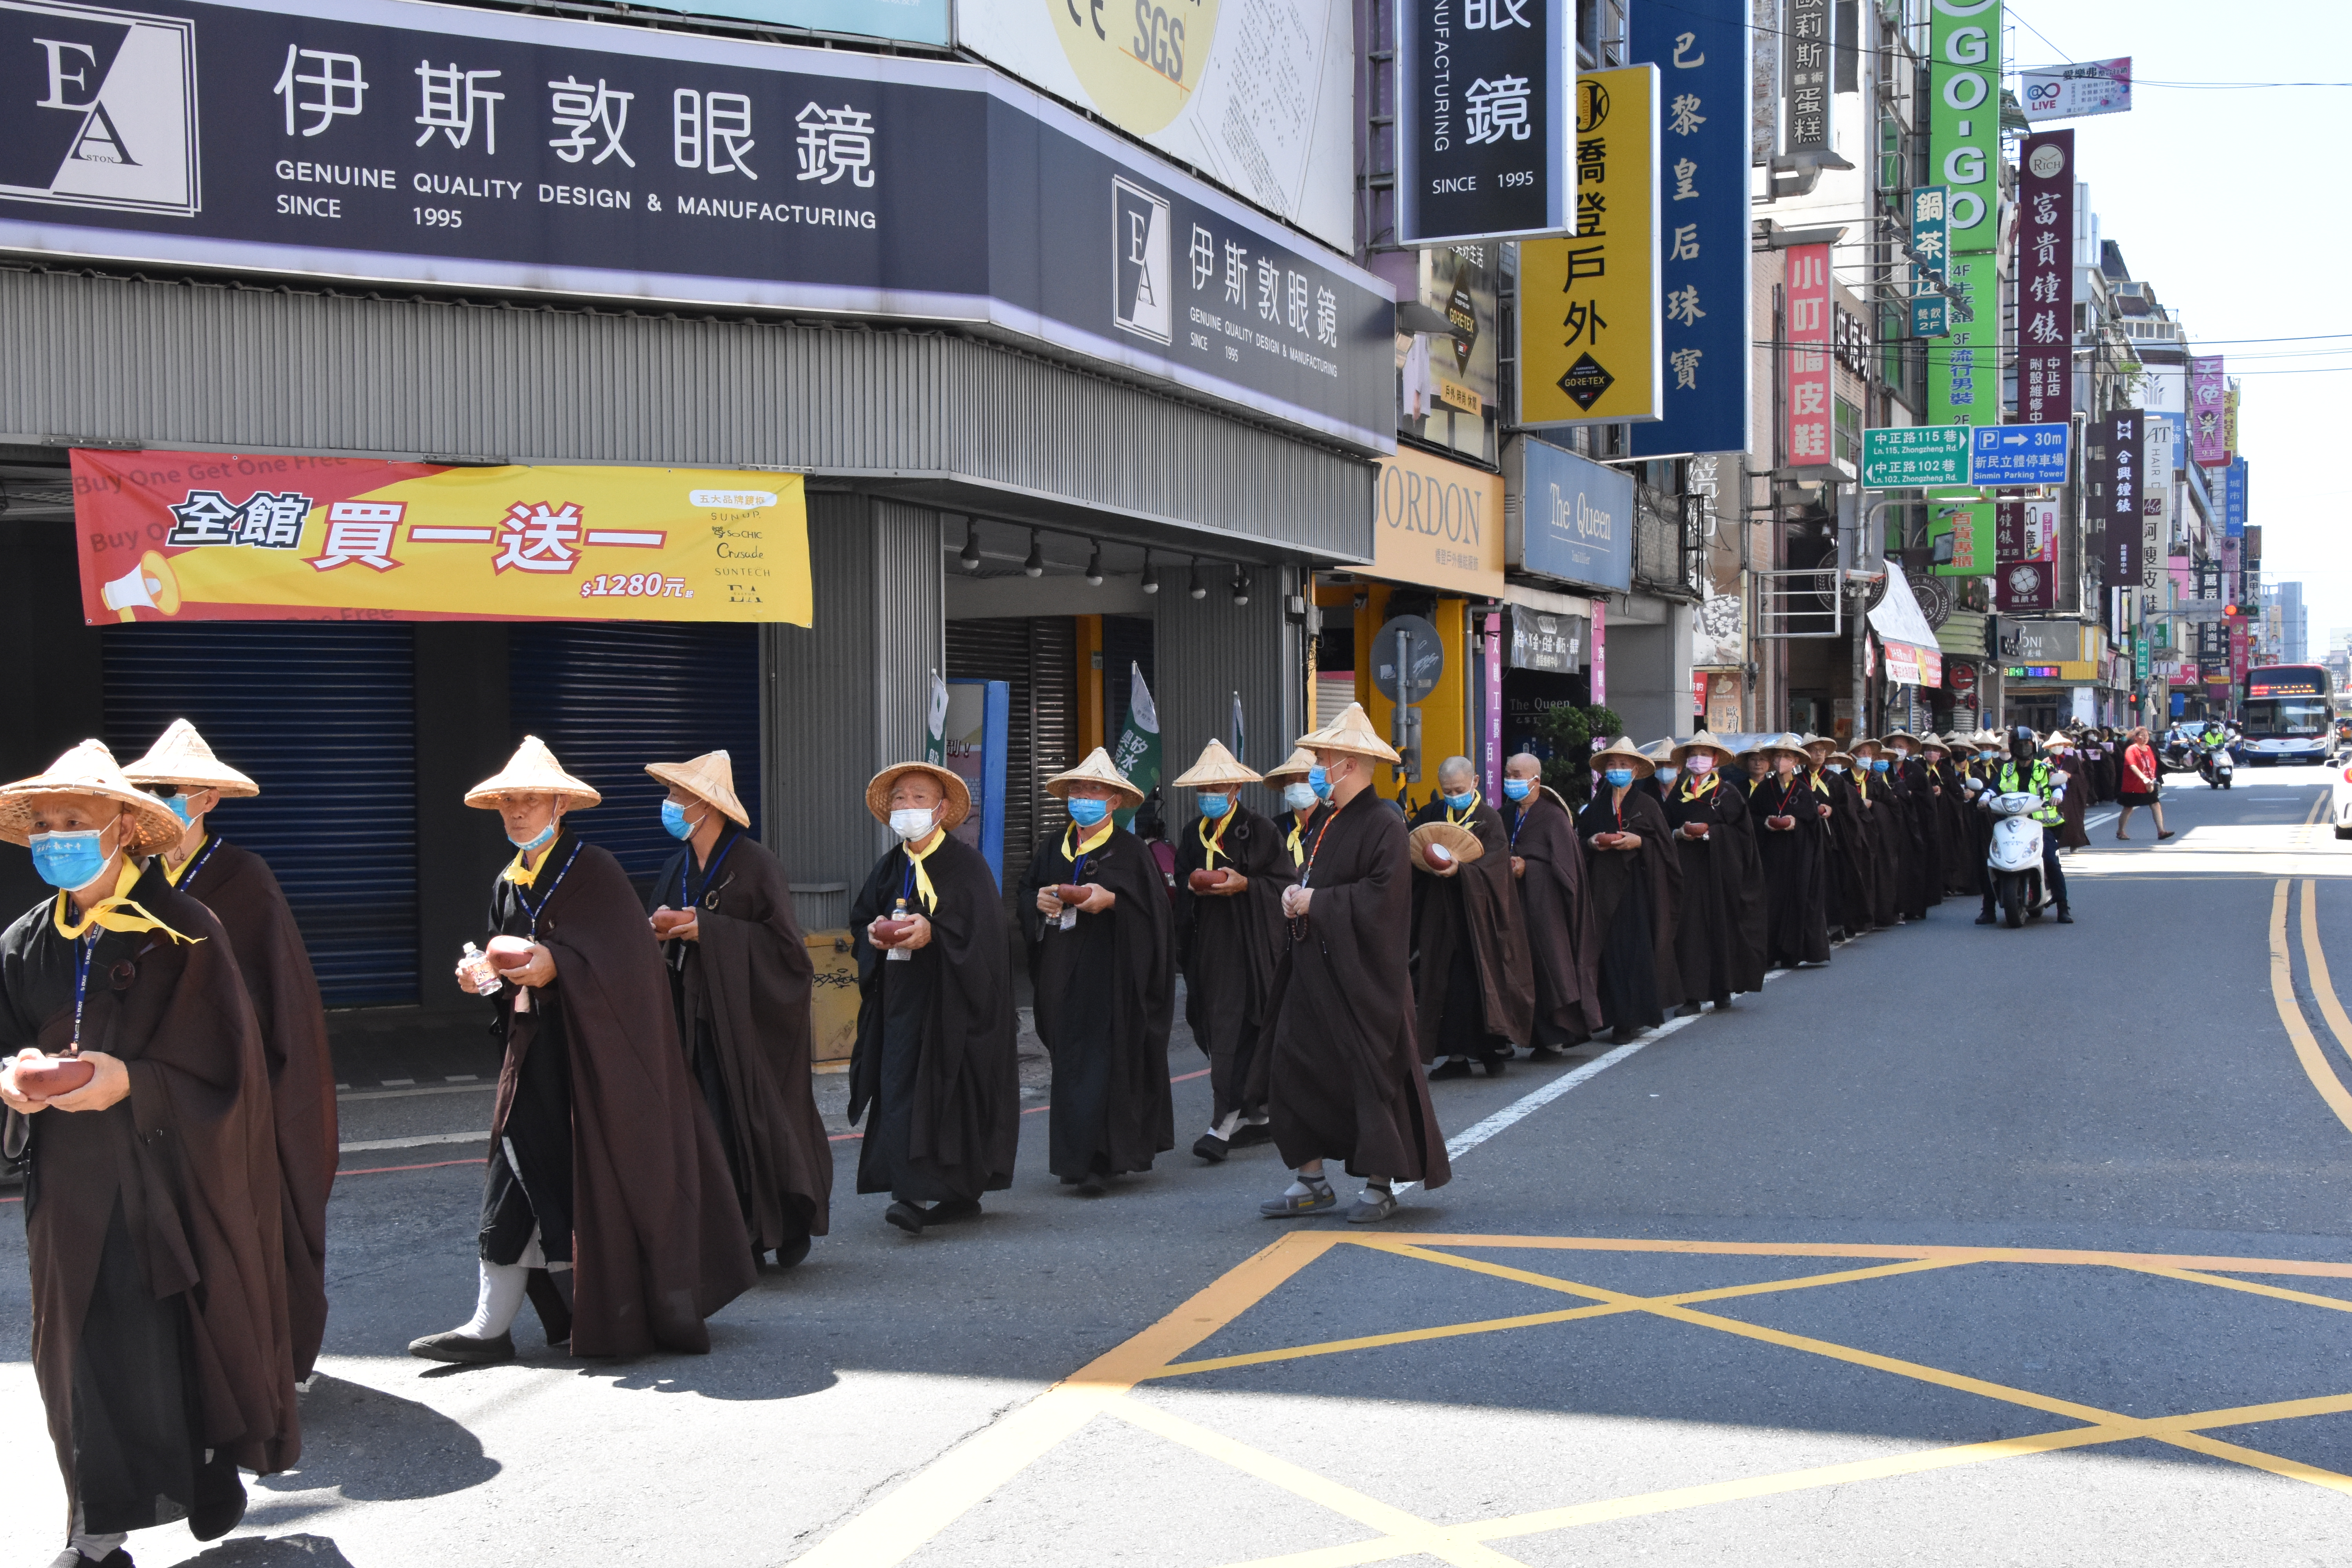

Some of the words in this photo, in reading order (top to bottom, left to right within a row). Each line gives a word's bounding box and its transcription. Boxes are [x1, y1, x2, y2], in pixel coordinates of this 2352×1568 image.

[1134, 0, 1184, 82] SGS
[274, 44, 875, 188] 伊斯敦眼鏡
[1794, 87, 1822, 144] 蛋糕
[86, 154, 114, 163] STON
[275, 160, 396, 190] GENUINE
[413, 173, 522, 200] QUALITY
[539, 183, 631, 209] DESIGN
[648, 194, 662, 212] &
[678, 196, 876, 229] MANUFACTURING
[1432, 176, 1477, 194] SINCE
[1497, 171, 1534, 187] 1995
[276, 195, 341, 218] SINCE
[413, 207, 462, 228] 1995
[1667, 31, 1707, 390] 巴黎皇后珠寶
[1953, 265, 1971, 277] 4F
[2028, 192, 2063, 344] 富貴鐘錶
[1190, 222, 1337, 348] 伊斯敦眼鏡
[1450, 308, 1474, 333] GORE-TEX
[1919, 322, 1940, 330] 2F
[1190, 307, 1221, 332] GENUINE
[1225, 321, 1253, 345] QUALITY
[1256, 332, 1280, 355] DESIGN
[1282, 345, 1287, 358] &
[1290, 348, 1338, 377] MANUFACTURING
[1190, 332, 1208, 352] SINCE
[1225, 346, 1238, 363] 1995
[1953, 333, 1971, 345] 3F
[1792, 256, 1825, 457] 小叮噹皮鞋
[1565, 376, 1605, 387] GORE-TEX
[1949, 349, 1974, 405] 流行男裝
[2047, 357, 2060, 397] 中正店
[2196, 360, 2221, 405] 天使
[1902, 445, 1944, 454] Zhongzheng
[1983, 433, 1995, 448] P
[2034, 432, 2062, 446] 30m
[1975, 453, 2064, 469] 新民立體停車場
[2151, 448, 2161, 476] HAIR
[73, 472, 121, 497] Buy
[130, 466, 181, 487] One
[188, 461, 230, 481] Get
[237, 457, 289, 477] One
[1902, 475, 1944, 483] Zhongzheng
[2004, 472, 2034, 480] Parking
[2116, 450, 2132, 512] 合興鐘錶
[700, 494, 765, 506] 五大品牌鏡框
[1550, 483, 1570, 529] The
[1577, 492, 1611, 541] Queen
[168, 491, 312, 549] 全館
[90, 530, 138, 554] Buy
[303, 501, 667, 575] 買一送一
[716, 542, 764, 559] Crusade
[715, 568, 770, 577] SUNTECH
[2139, 646, 2147, 672] 中正路
[1510, 698, 1529, 710] The
[1534, 697, 1570, 711] Queen
[1726, 706, 1739, 733] 歐莉
